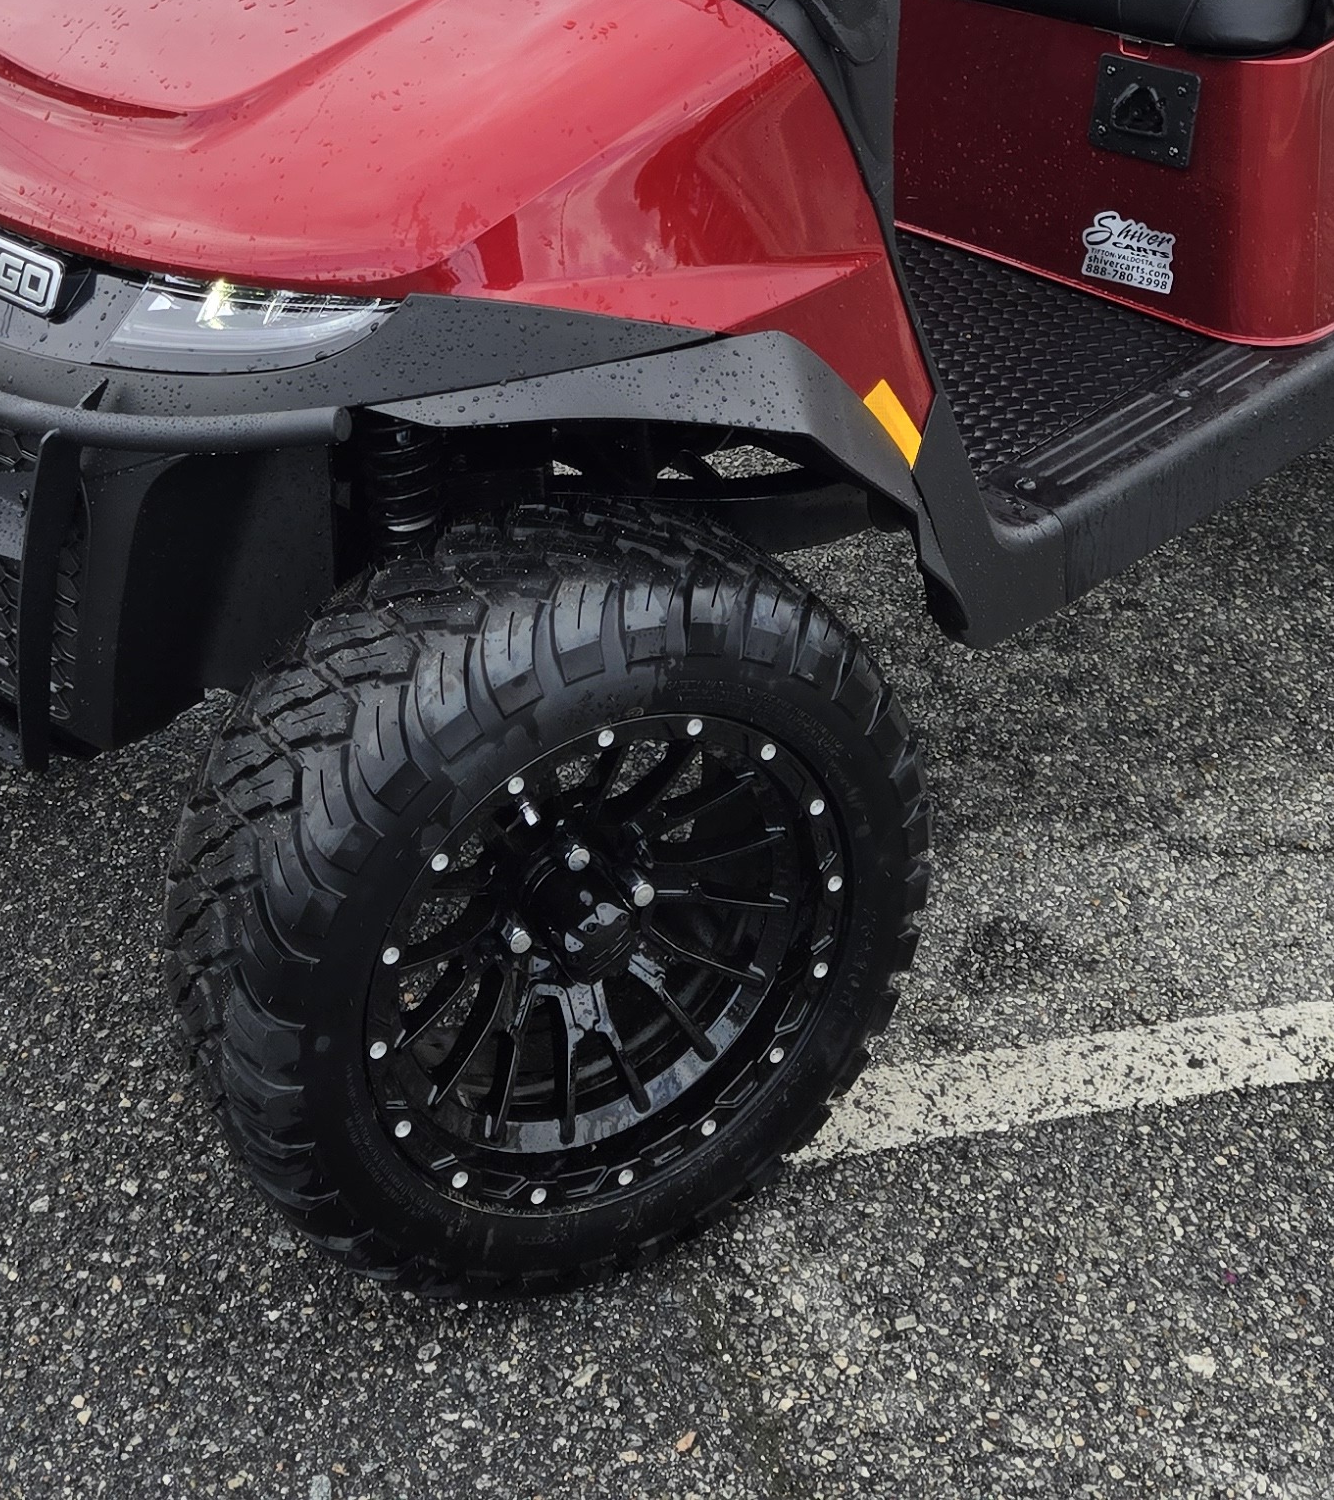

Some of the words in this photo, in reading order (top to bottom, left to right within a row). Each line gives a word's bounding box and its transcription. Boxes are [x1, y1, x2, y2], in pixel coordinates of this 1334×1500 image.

[1085, 215, 1173, 248] Shiver
[1112, 241, 1170, 259] CARTS
[1085, 263, 1168, 290] 888-780-2998
[1088, 254, 1170, 280] shivercarts.com
[1156, 262, 1167, 270] GA
